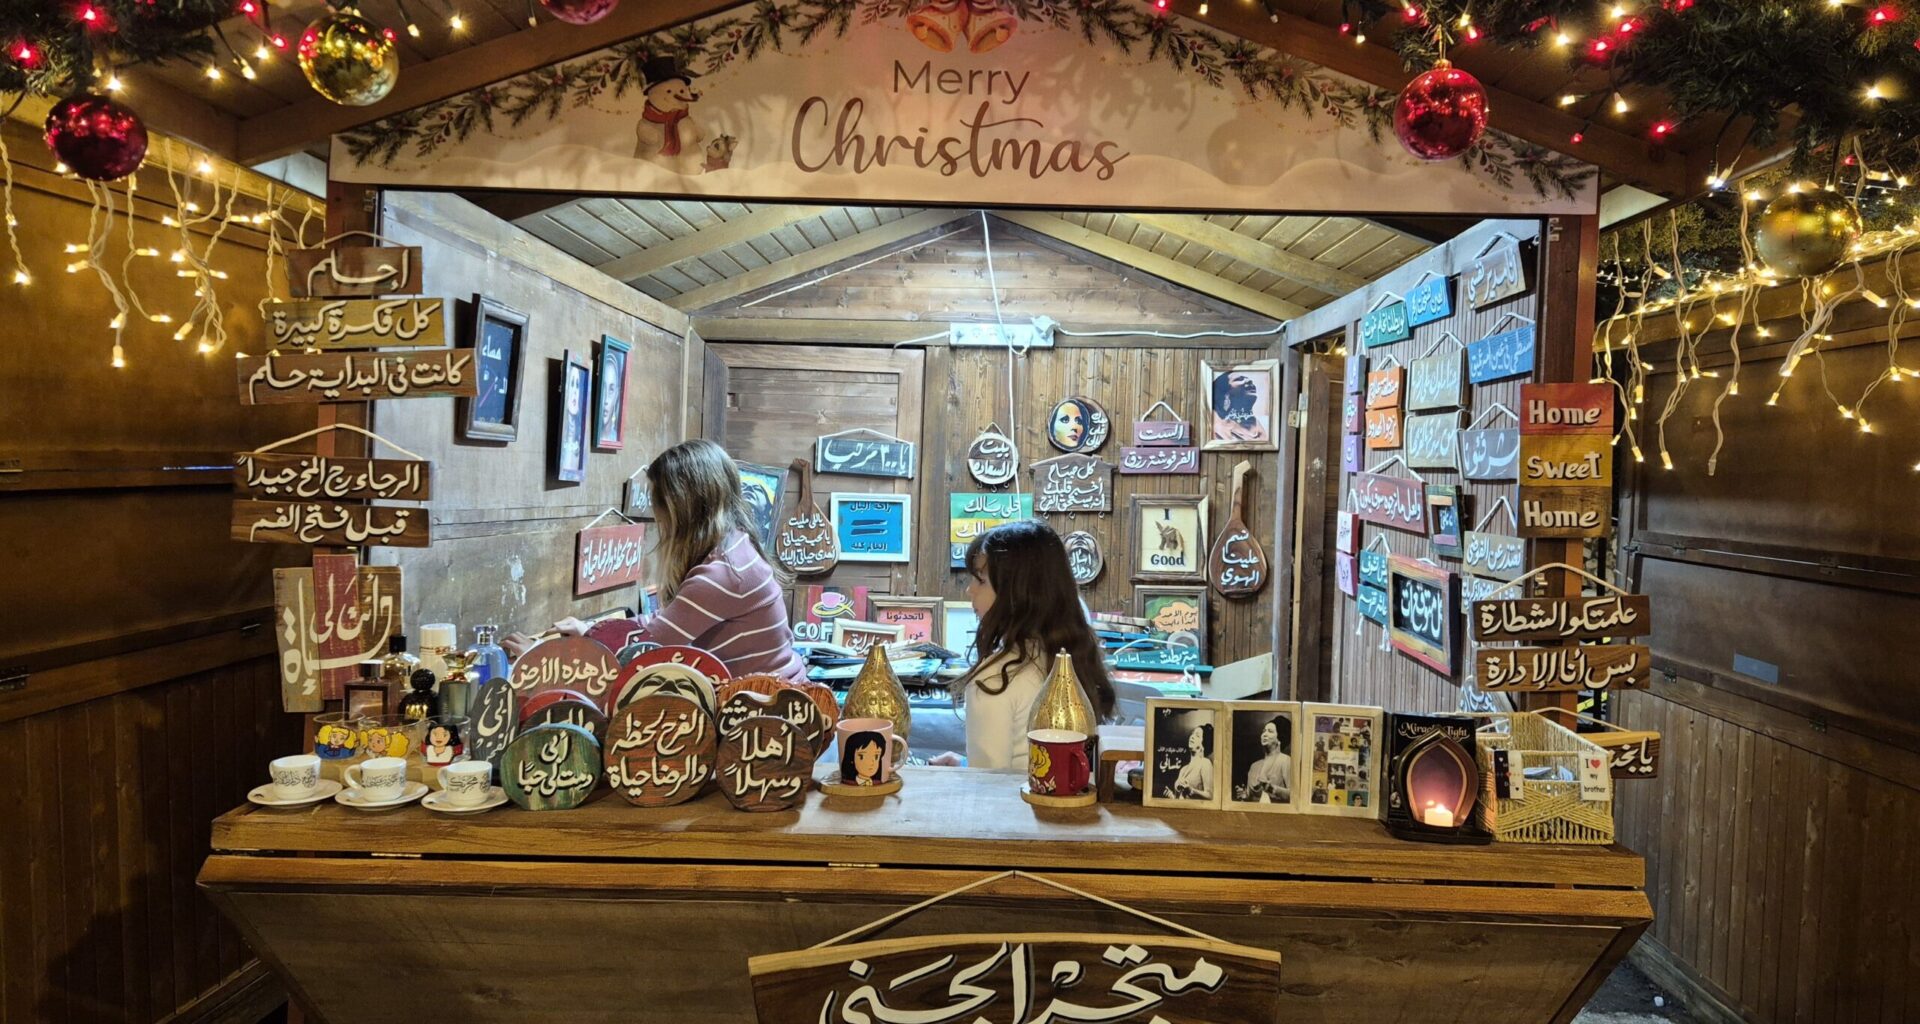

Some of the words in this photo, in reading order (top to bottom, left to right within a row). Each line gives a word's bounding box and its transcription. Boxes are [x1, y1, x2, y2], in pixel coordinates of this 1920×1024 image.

[893, 60, 1030, 104] Merry
[791, 96, 1131, 181] Christmas
[273, 300, 347, 347] كبيرة
[328, 299, 408, 341] فكرة
[395, 301, 441, 339] كل
[249, 356, 308, 404] حلم
[308, 355, 387, 398] البداية
[411, 352, 471, 387] كانت
[1529, 400, 1601, 425] Home
[1139, 424, 1184, 440] الست
[297, 457, 325, 497] المخ
[325, 465, 353, 497] رج
[352, 461, 420, 497] الرجاء
[1077, 460, 1097, 479] كل
[1527, 451, 1602, 479] Sweet
[250, 504, 301, 543] الفم
[300, 504, 349, 543] فتح
[346, 508, 410, 543] قبل
[1164, 508, 1170, 521] I
[1523, 501, 1601, 528] Home
[1481, 601, 1567, 635] الشطارة
[1560, 597, 1638, 636] علمتكو
[510, 656, 560, 690] الأرض
[563, 659, 600, 686] هذه
[587, 655, 619, 696] على
[1560, 649, 1586, 683] أنا
[1585, 653, 1637, 689] بس
[779, 701, 815, 727] القل
[1398, 722, 1437, 740] Mirac
[657, 708, 705, 756] الفرح
[606, 756, 652, 797] حياة
[652, 754, 708, 797] والرضا
[1585, 758, 1590, 769] I
[1584, 785, 1606, 793] brother
